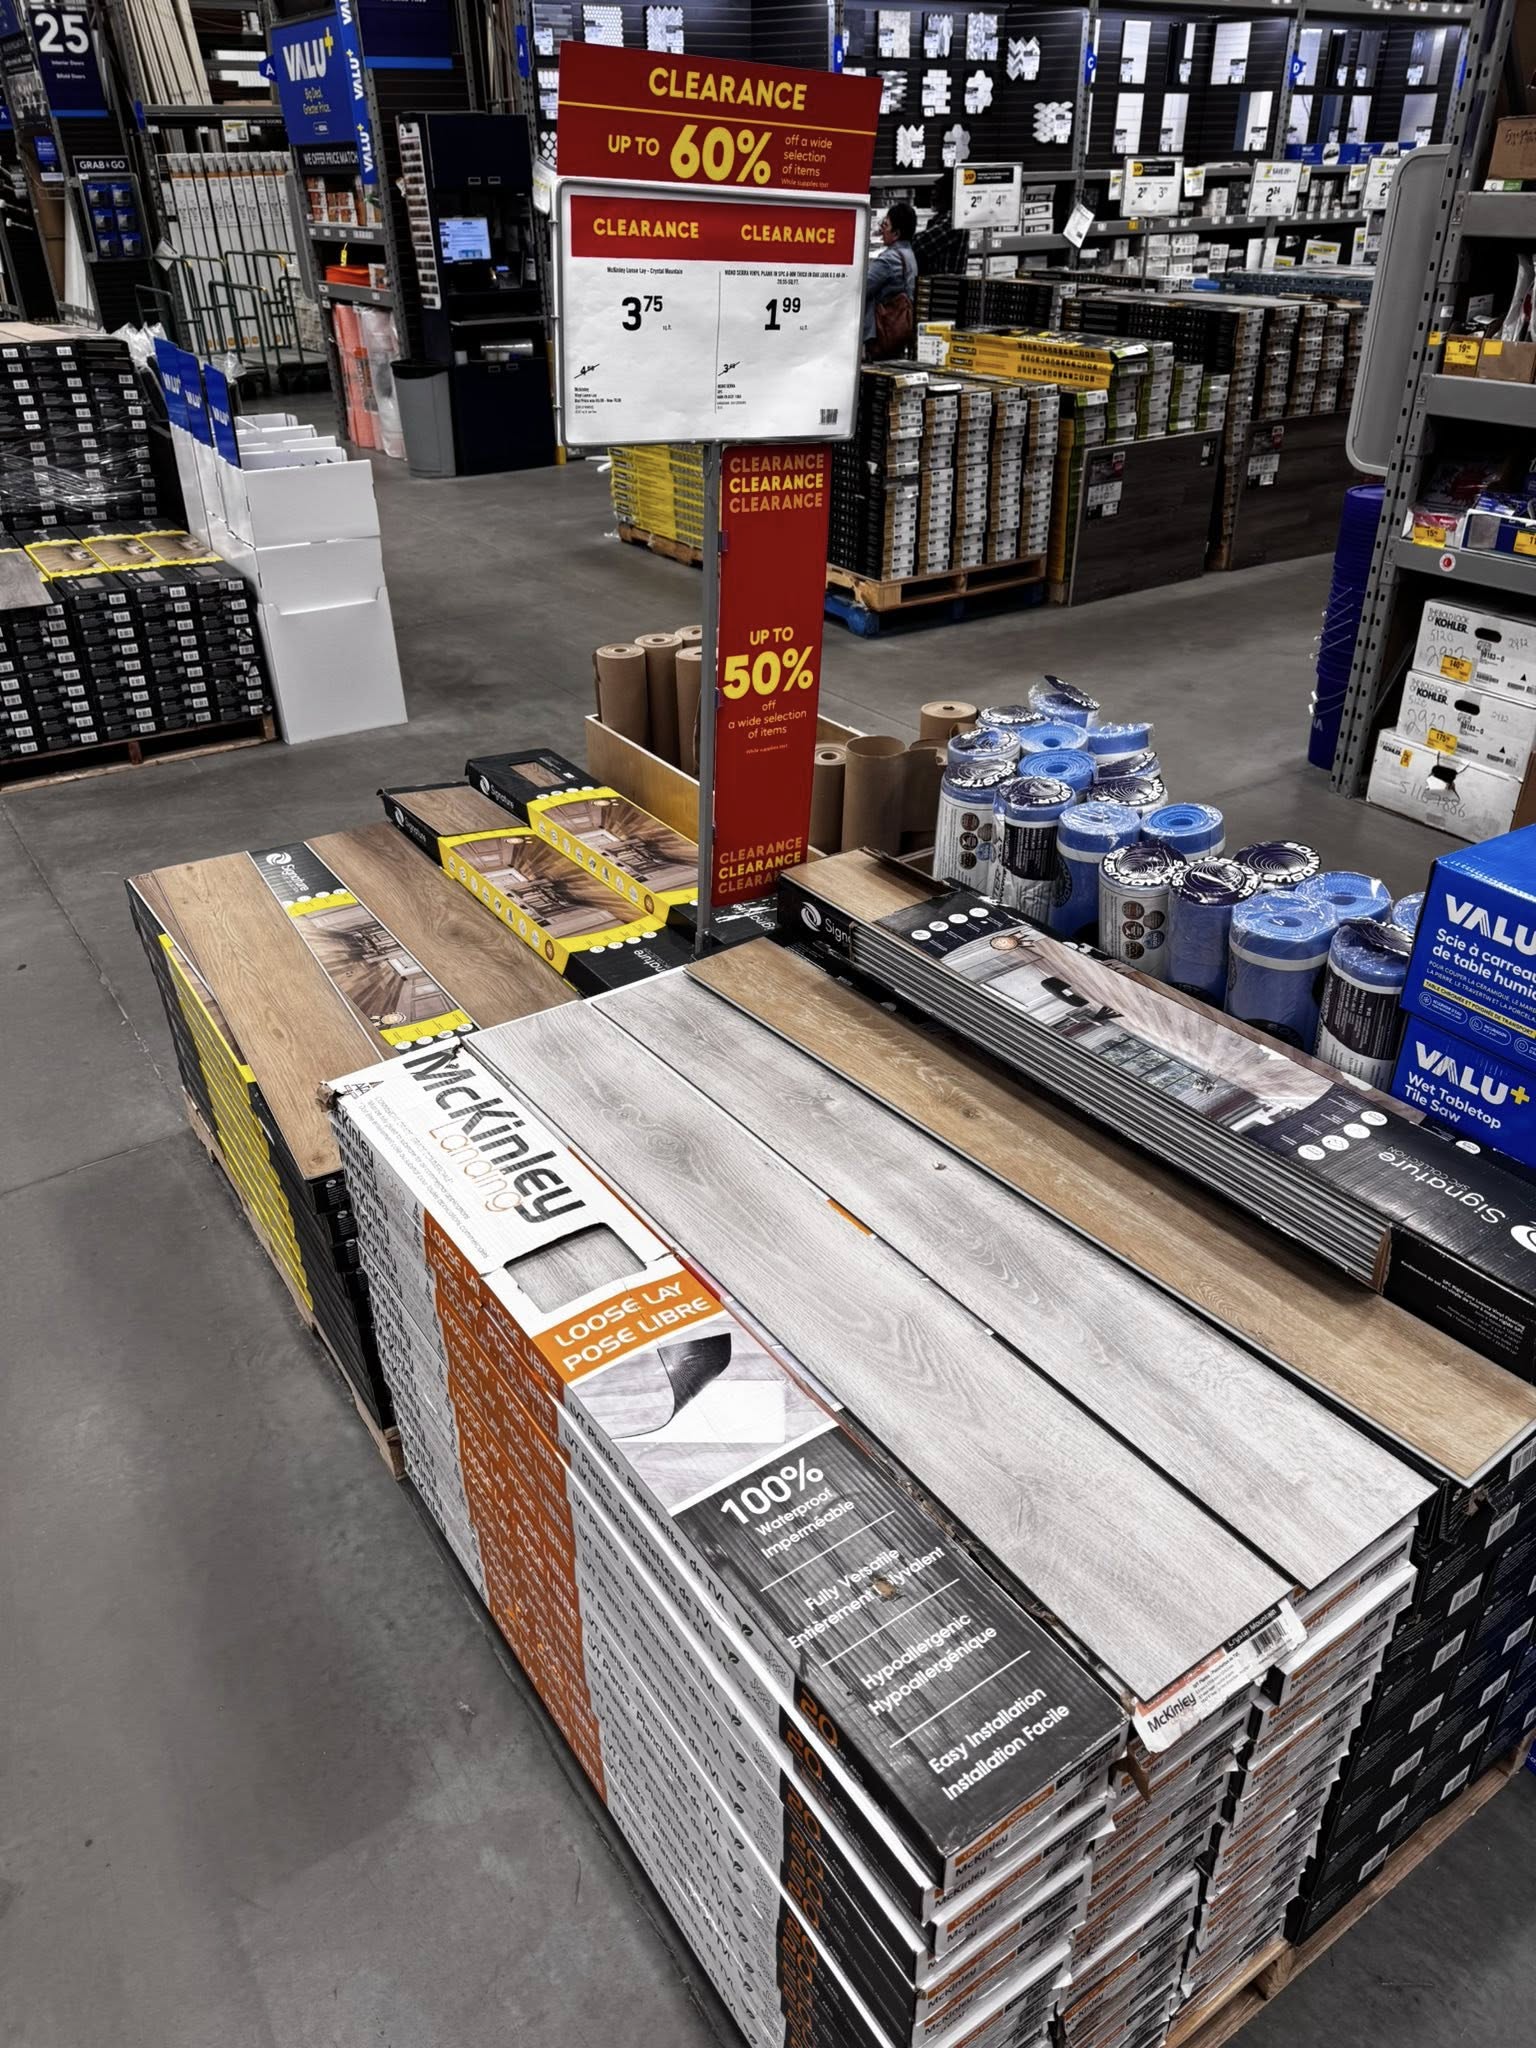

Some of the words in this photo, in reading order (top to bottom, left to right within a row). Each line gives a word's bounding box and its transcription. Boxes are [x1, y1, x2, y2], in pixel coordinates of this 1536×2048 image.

[34, 12, 89, 54] 25
[266, 63, 275, 75] A
[1087, 56, 1094, 68] C
[1293, 63, 1299, 73] D
[649, 67, 808, 111] CLEARANCE
[608, 134, 632, 154] UP
[635, 136, 660, 157] TO
[670, 124, 772, 185] 60%
[783, 150, 826, 163] selection
[785, 134, 799, 146] off
[801, 138, 808, 148] a
[810, 136, 833, 150] wide
[80, 160, 105, 170] GRAB
[110, 161, 125, 169] GO
[782, 163, 793, 175] of
[794, 164, 821, 177] items
[593, 218, 700, 239] CLEARANCE
[741, 225, 836, 244] CLEARANCE
[729, 473, 824, 494] CLEARANCE
[730, 453, 825, 474] CLEARANCE
[729, 493, 823, 514] CLEARANCE
[749, 629, 770, 646] UP
[772, 626, 794, 643] TO
[722, 646, 814, 700] 50%
[728, 721, 735, 730] a
[738, 717, 762, 728] wide
[764, 710, 807, 724] selection
[762, 700, 777, 712] off
[748, 728, 759, 739] of
[761, 726, 787, 737] items
[718, 851, 801, 880] CLEARANCE
[719, 836, 802, 865] CLEARANCE
[281, 863, 310, 892] Signature
[1432, 945, 1451, 960] de
[1454, 953, 1492, 979] table
[1436, 928, 1467, 951] Scie
[1469, 943, 1480, 957] à
[1415, 1041, 1530, 1105] VALU+
[1405, 1084, 1428, 1107] Tile
[1431, 1100, 1461, 1123] Saw
[1409, 1071, 1436, 1095] Wet
[1440, 1087, 1501, 1129] Tabletop
[403, 1051, 586, 1224] McKinley
[429, 1119, 523, 1213] Landing
[1378, 1151, 1506, 1225] Signature
[429, 1223, 462, 1273] LOOSE
[464, 1265, 481, 1296] LAY
[524, 1341, 559, 1397] LIBRE
[555, 1297, 643, 1348] LOOSE
[643, 1281, 685, 1306] LAY
[562, 1327, 637, 1373] POSE
[638, 1296, 712, 1333] LIBRE
[570, 1403, 586, 1428] LVT
[588, 1424, 620, 1473] Planks
[627, 1476, 688, 1560] Planchettes
[690, 1559, 703, 1582] de
[720, 1457, 825, 1525] 100%
[581, 1453, 613, 1500] Planks
[618, 1502, 677, 1586] Planchettes
[755, 1487, 835, 1539] Waterproof
[761, 1500, 855, 1560] Imperméable
[589, 1514, 619, 1561] Planks
[804, 1582, 840, 1611] Fully
[838, 1547, 900, 1588] Versatile
[787, 1589, 875, 1651] Entièrement
[1249, 1608, 1277, 1632] Mountain
[860, 1612, 972, 1692] Hypoallergenic
[868, 1626, 997, 1718] Hypoallergénique
[928, 1743, 967, 1775] Easy
[965, 1686, 1047, 1750] Installation
[1147, 1691, 1197, 1734] McKinley
[942, 1728, 1026, 1801] Installation
[1023, 1703, 1070, 1744] Facile
[955, 1833, 1009, 1877] McKinley
